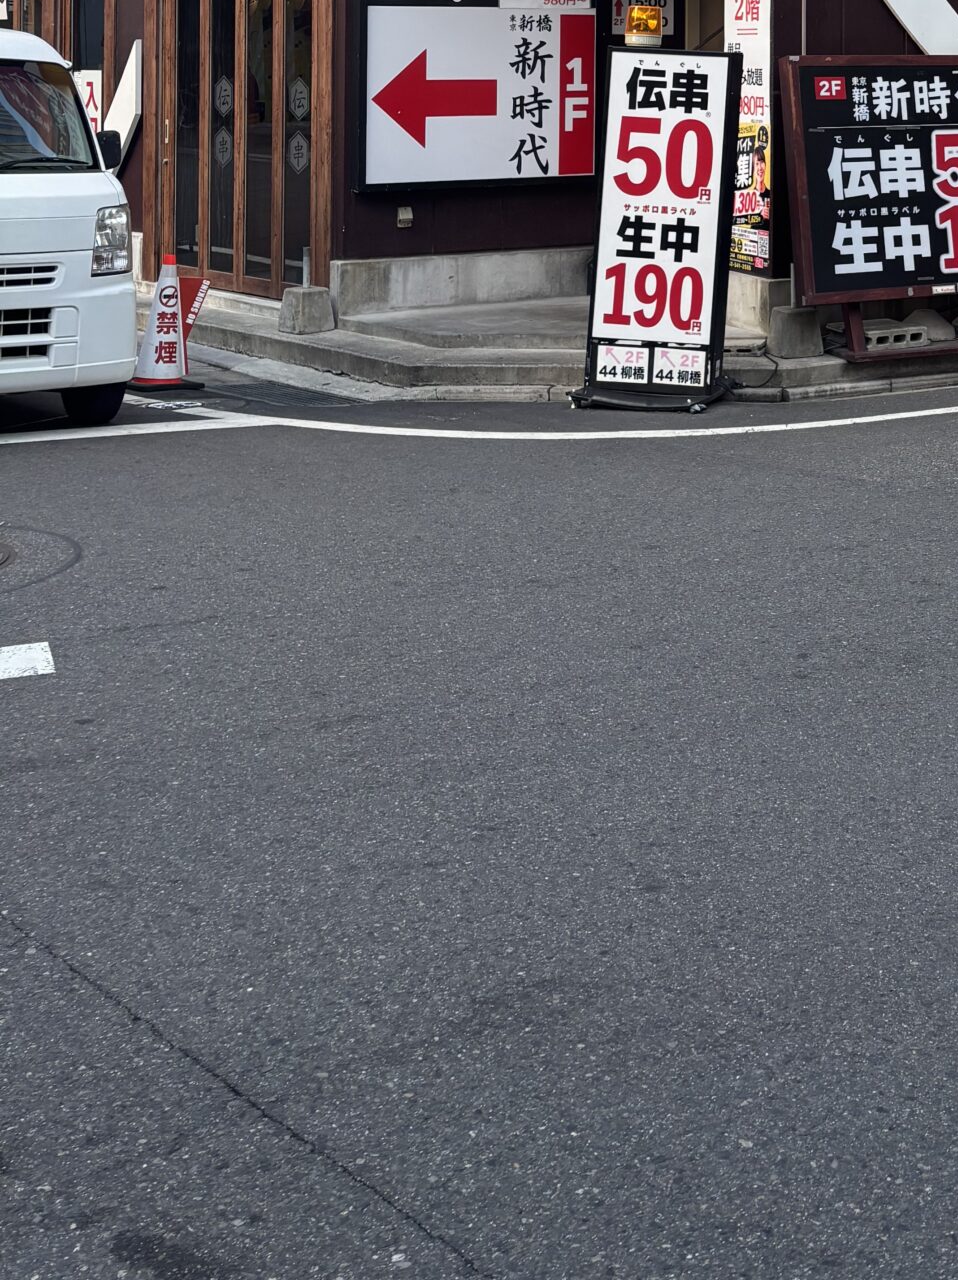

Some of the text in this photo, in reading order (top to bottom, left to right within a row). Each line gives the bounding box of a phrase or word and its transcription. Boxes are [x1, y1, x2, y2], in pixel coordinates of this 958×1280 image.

[520, 14, 552, 32] 新橋
[638, 59, 701, 69] でんぐし
[852, 76, 867, 86] 東京
[564, 58, 589, 132] 1F
[626, 67, 709, 114] 伝串
[819, 80, 841, 96] 2F
[852, 87, 870, 121] 新橋
[509, 37, 553, 175] 新時代
[834, 133, 914, 144] でんぐし
[828, 144, 925, 200] 伝串
[616, 216, 699, 263] 生中
[832, 217, 931, 274] 生中
[191, 279, 211, 313] SMOKING
[155, 311, 178, 364] 禁煙
[625, 351, 644, 363] 2F
[680, 355, 699, 367] 2F
